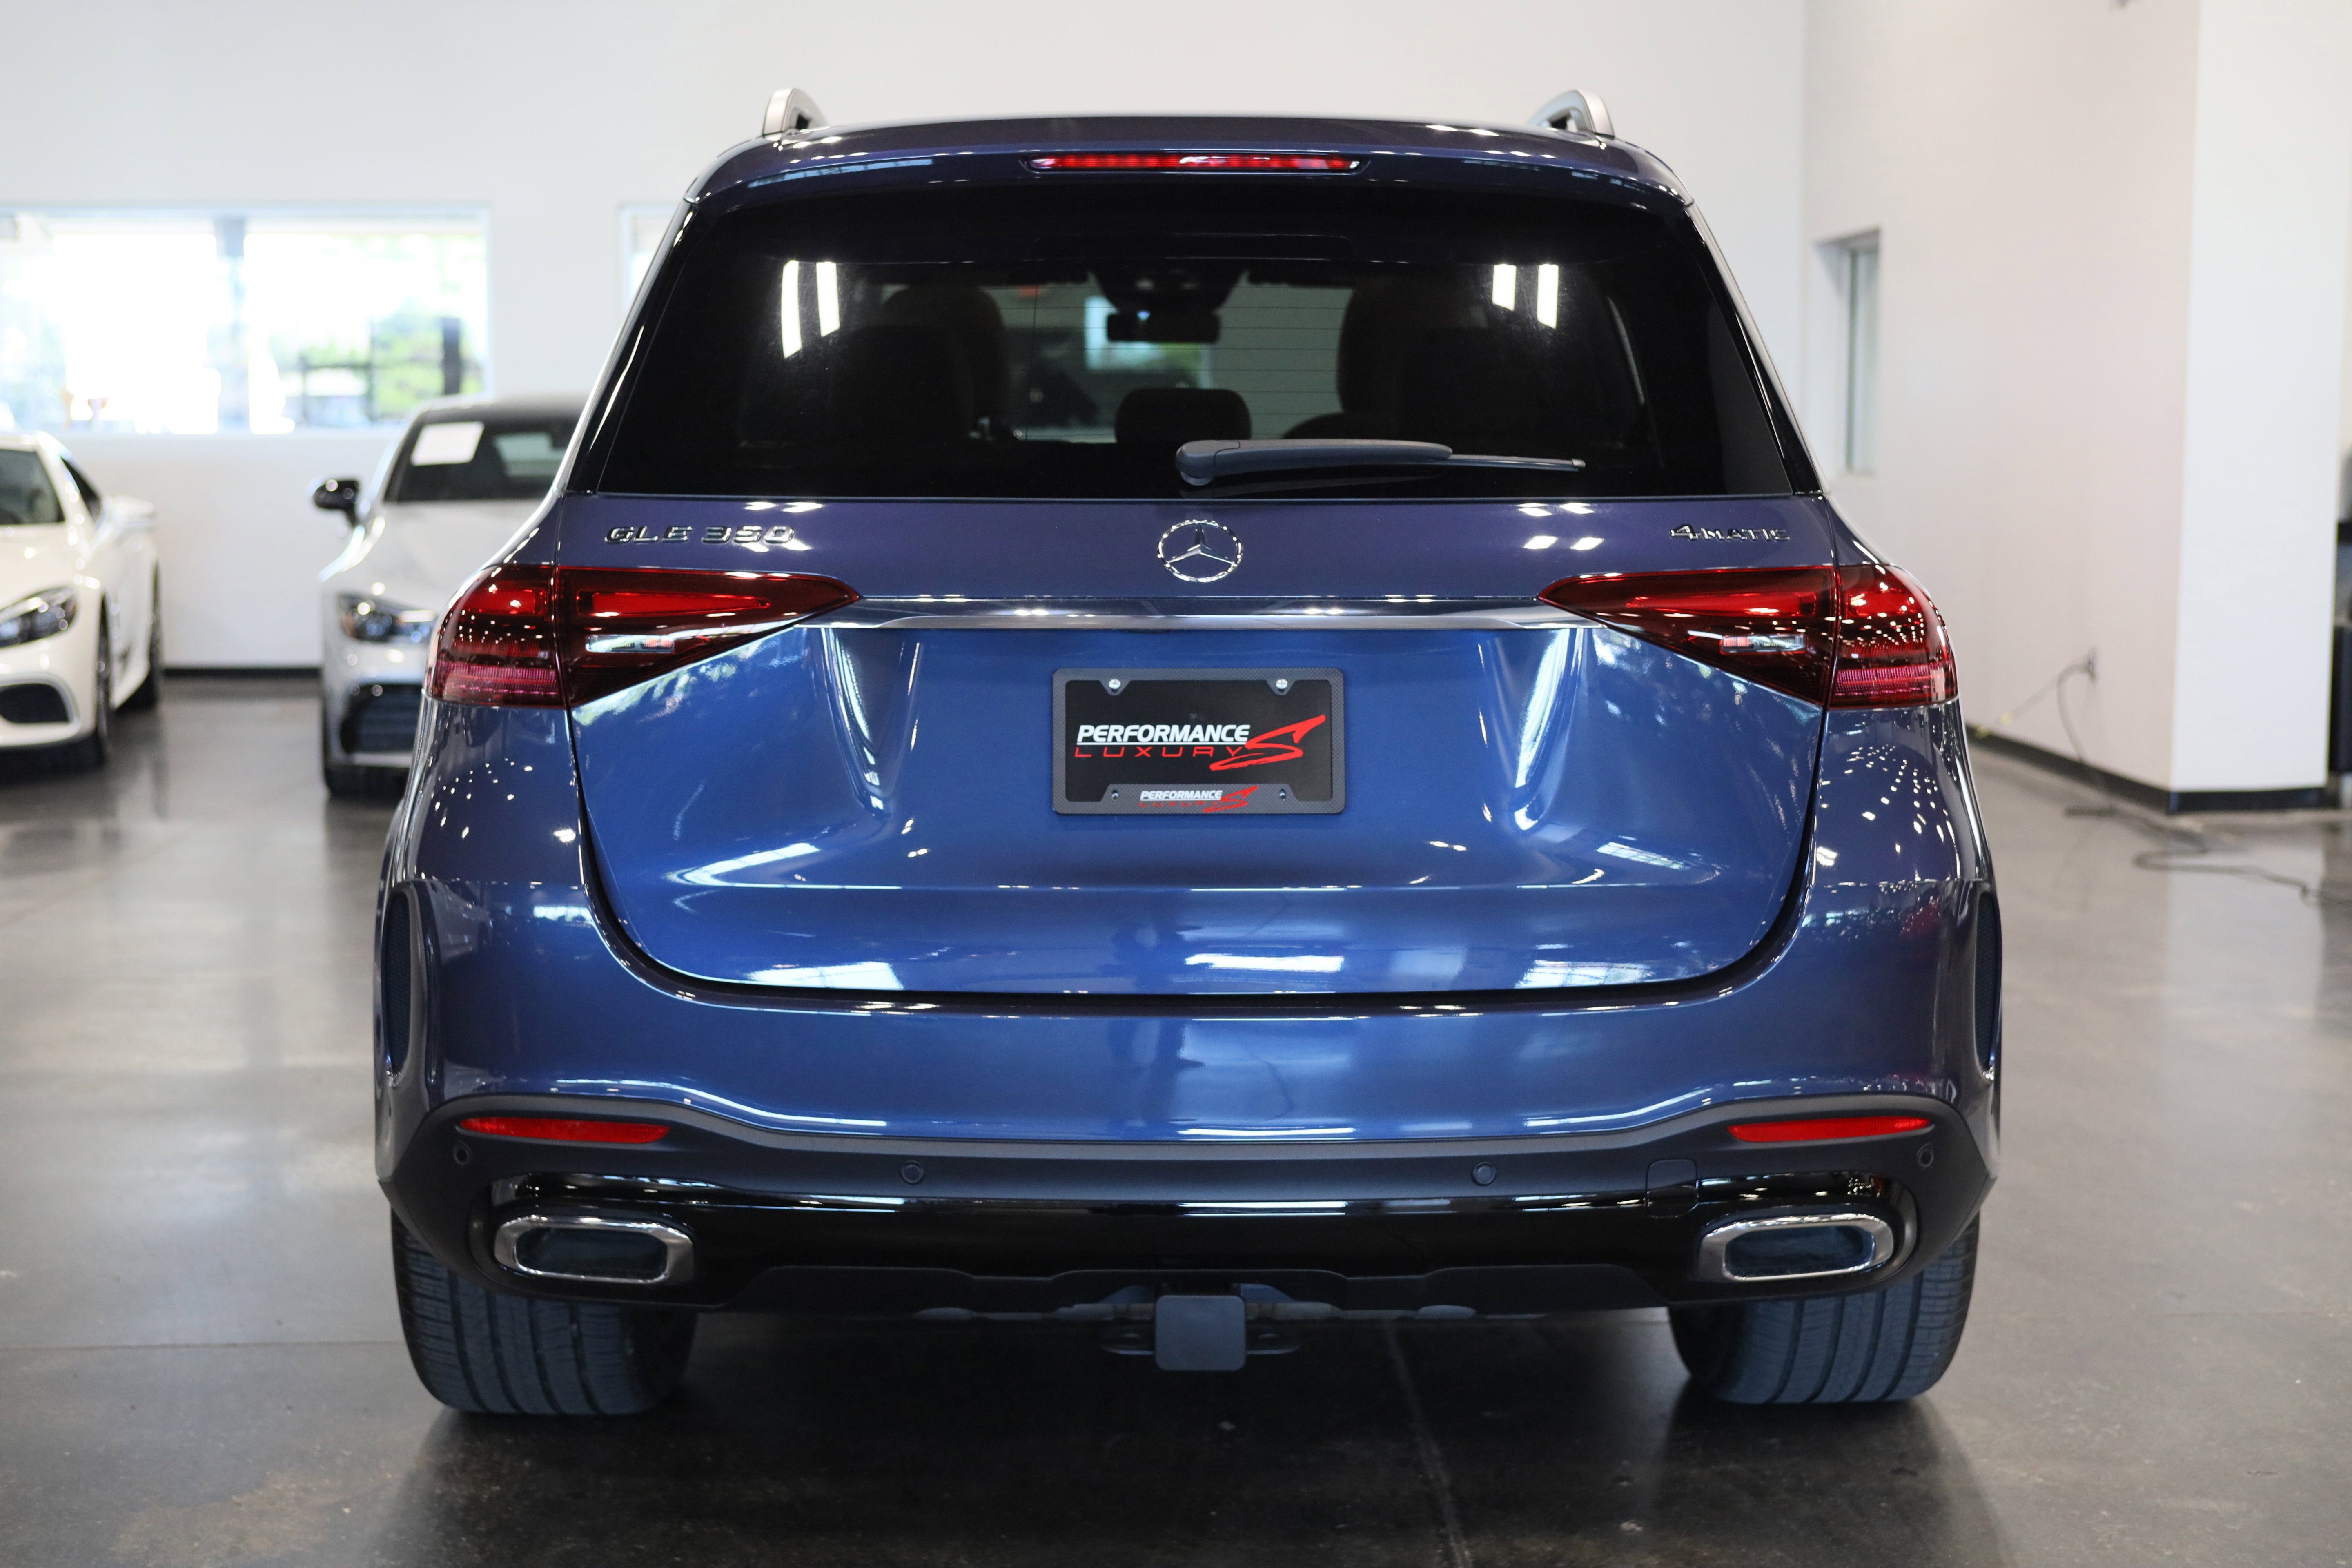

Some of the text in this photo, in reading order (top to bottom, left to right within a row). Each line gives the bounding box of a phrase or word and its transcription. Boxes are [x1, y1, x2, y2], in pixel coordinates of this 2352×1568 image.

[605, 526, 795, 543] GLE 350
[1076, 724, 1251, 742] PERFORMANCE
[1074, 746, 1243, 757] LUXURY
[1140, 790, 1223, 800] PERFORMANCE
